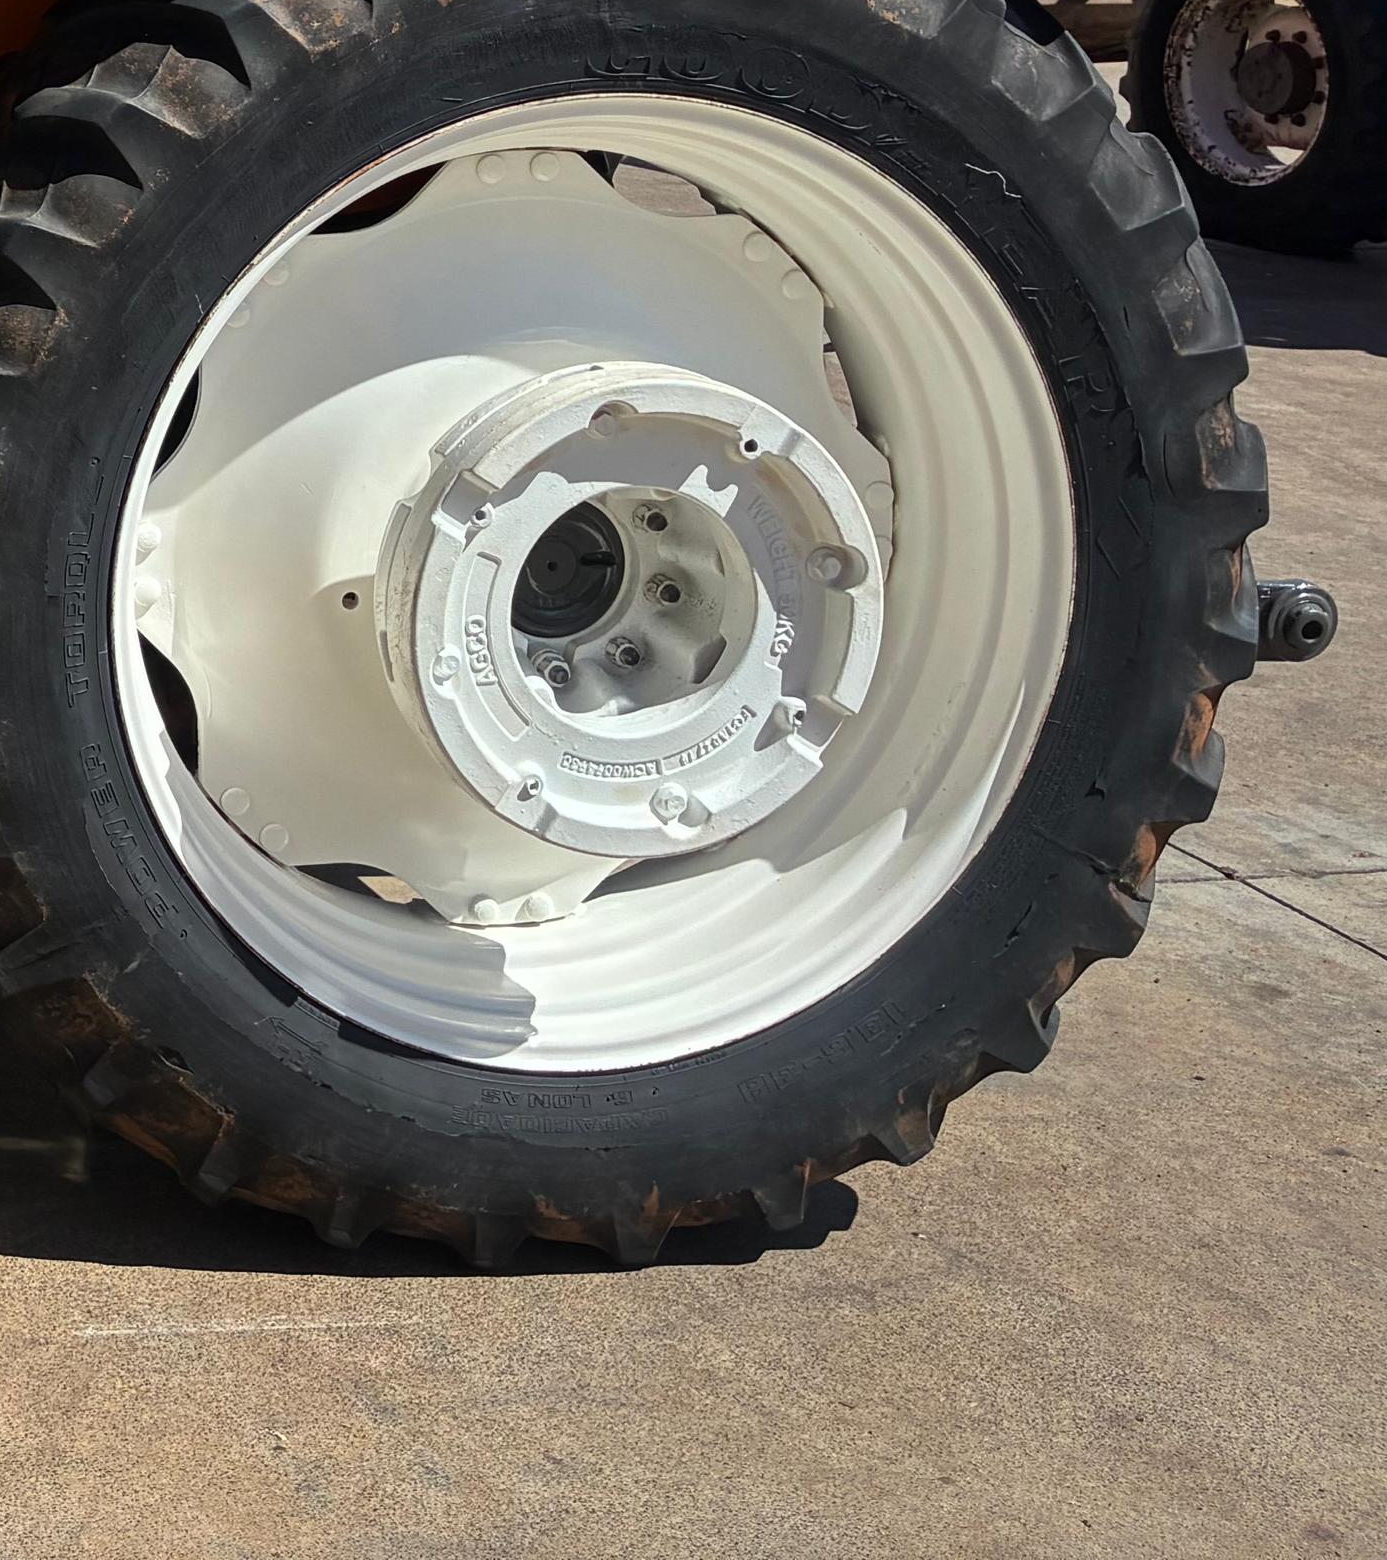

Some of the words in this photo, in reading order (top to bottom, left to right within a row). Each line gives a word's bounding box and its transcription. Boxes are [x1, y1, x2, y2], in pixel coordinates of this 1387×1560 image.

[66, 470, 105, 708] TORQ
[465, 614, 498, 687] AGCO
[81, 742, 178, 929] POWER
[477, 1078, 593, 1117] LONAS
